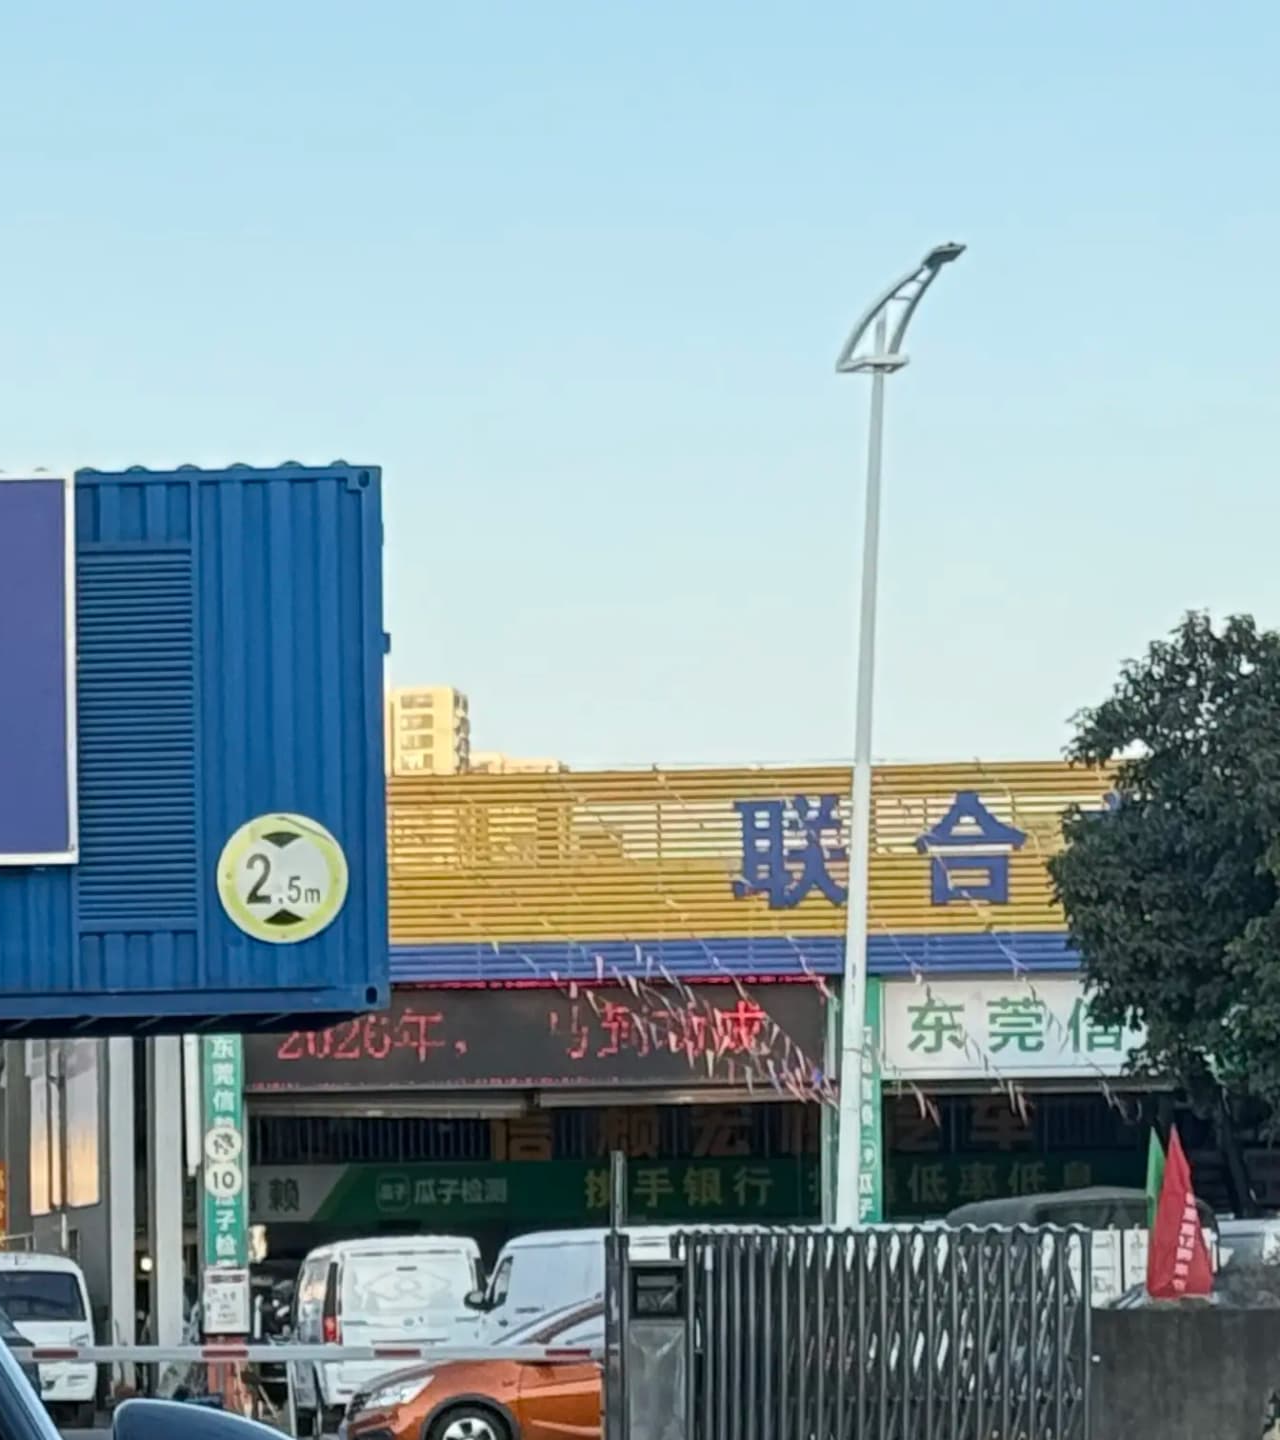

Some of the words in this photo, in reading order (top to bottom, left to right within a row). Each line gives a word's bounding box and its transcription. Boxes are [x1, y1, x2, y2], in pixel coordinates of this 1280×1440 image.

[732, 790, 1028, 909] 联合
[245, 853, 321, 905] 2.5m
[216, 1171, 235, 1190] 10
